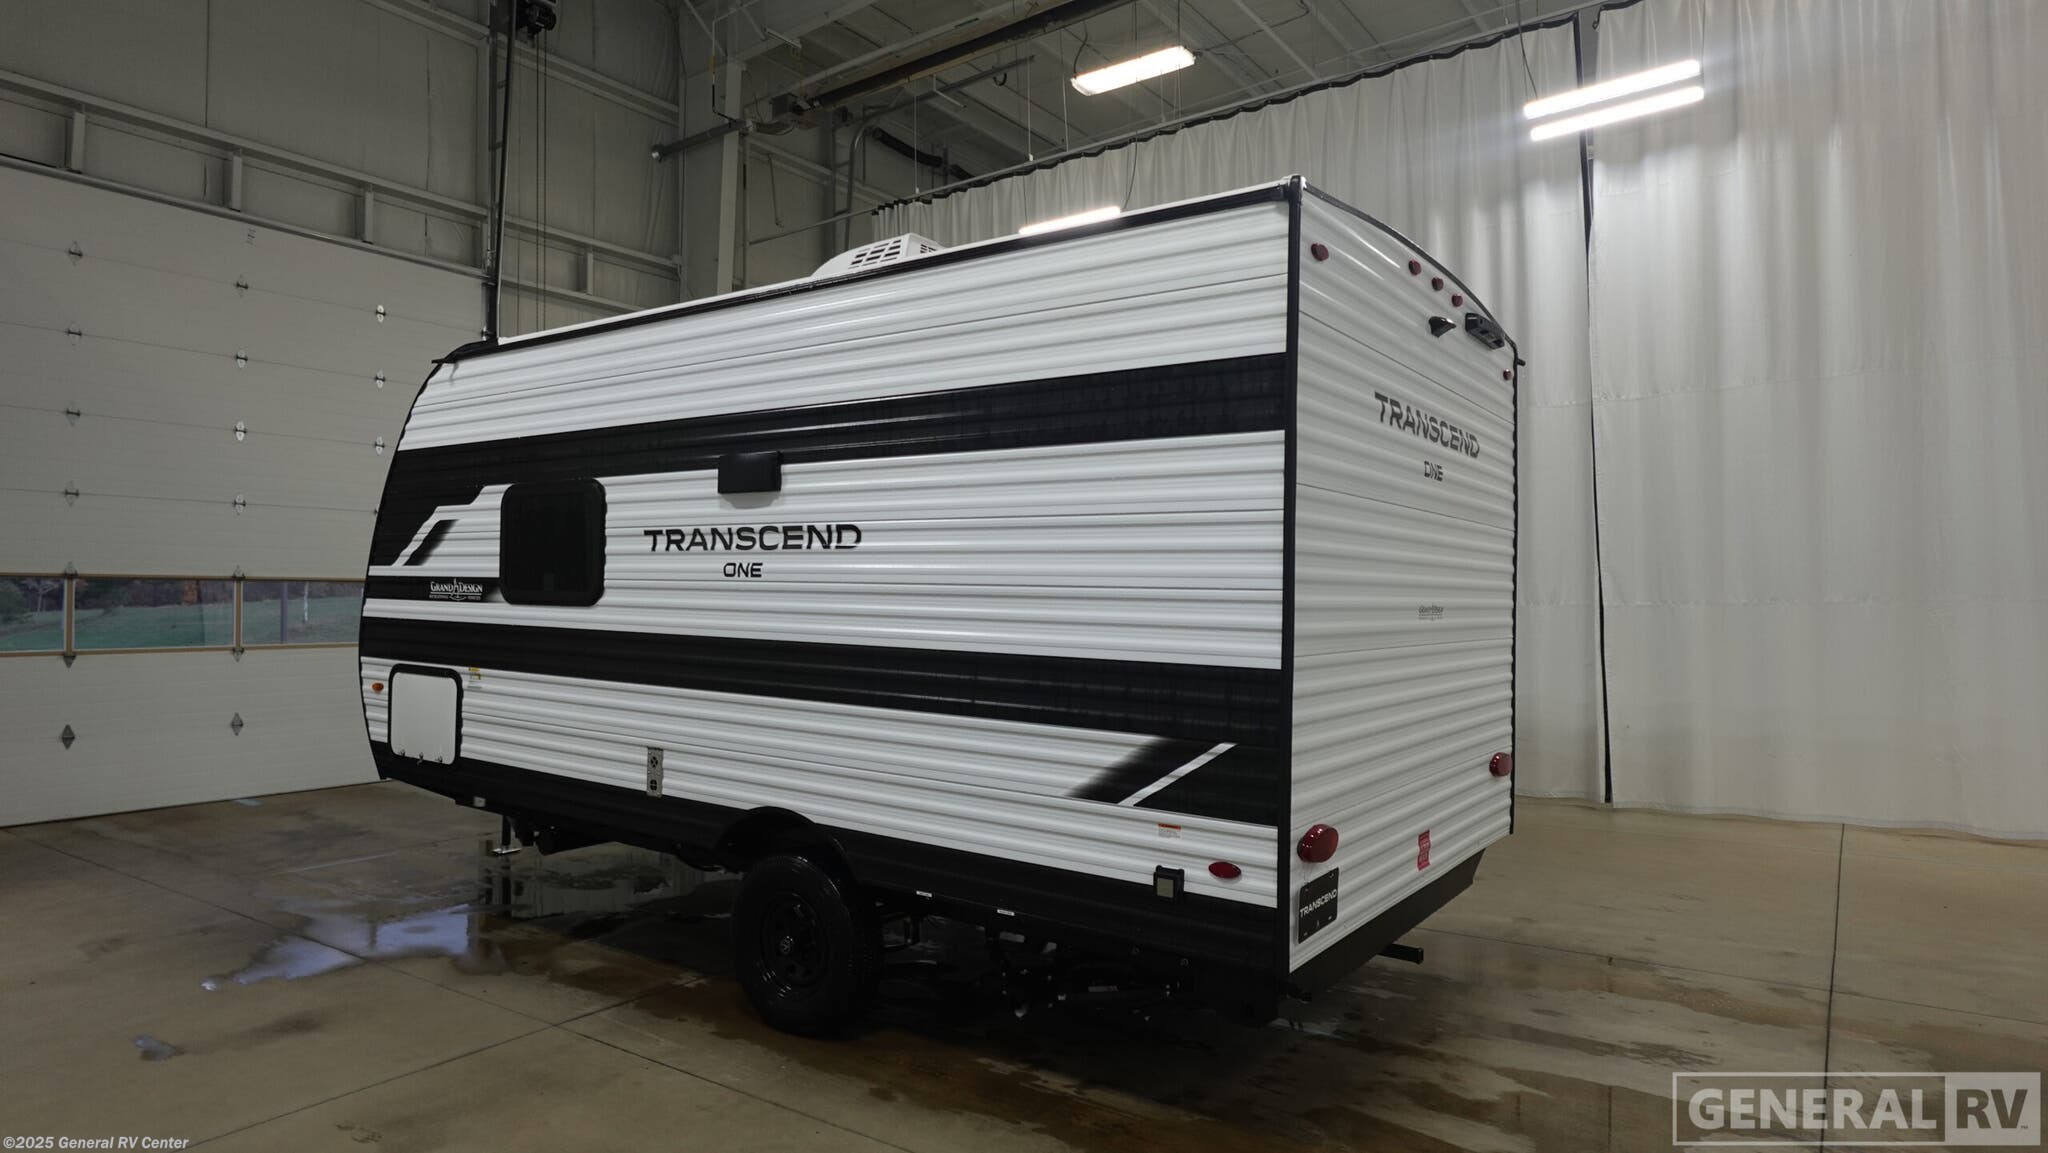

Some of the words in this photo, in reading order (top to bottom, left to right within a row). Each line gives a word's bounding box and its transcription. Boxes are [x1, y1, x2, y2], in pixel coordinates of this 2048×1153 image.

[1374, 391, 1481, 459] TRANSCEND
[1423, 460, 1444, 482] ONE
[643, 523, 862, 552] TRANSCEND
[723, 562, 763, 578] ONE
[430, 580, 454, 592] GRAND
[458, 582, 483, 593] DESIGN
[1299, 889, 1338, 918] TRANSCEND
